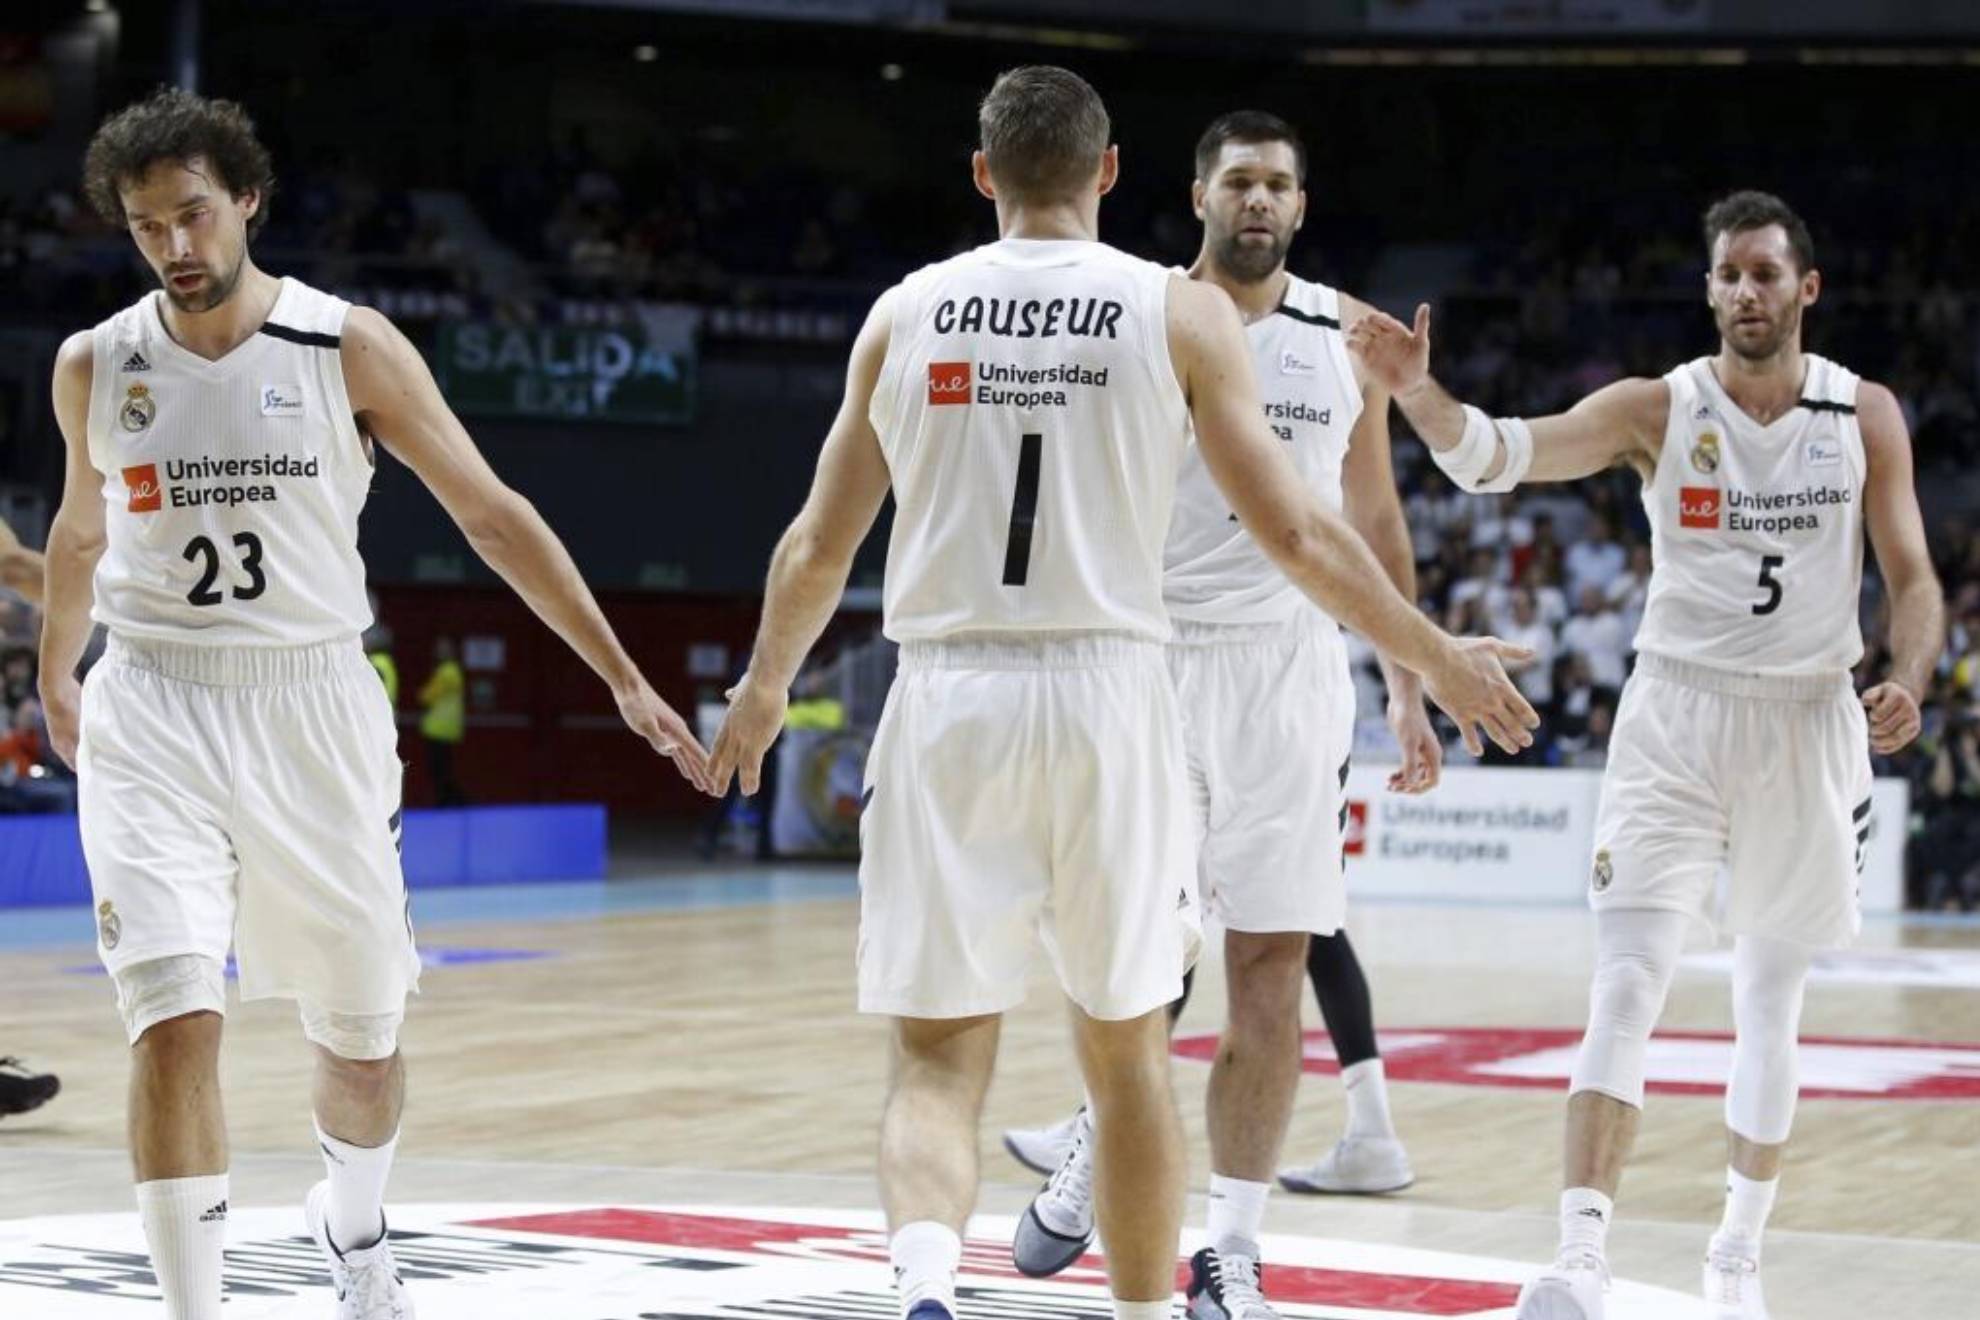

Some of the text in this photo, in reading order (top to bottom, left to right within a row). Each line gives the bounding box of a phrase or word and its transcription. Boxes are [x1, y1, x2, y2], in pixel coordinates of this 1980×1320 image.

[934, 296, 1122, 339] CAUSEUR
[453, 323, 680, 381] SALIDA
[978, 362, 1109, 387] Universidad
[976, 386, 1067, 410] Europea
[1264, 400, 1331, 425] rsidad
[166, 454, 319, 480] Universidad
[170, 485, 277, 507] Europea
[1002, 434, 1042, 586] 1
[1728, 513, 1819, 534] Europea
[182, 531, 266, 606] 23
[1751, 556, 1784, 615] 5
[1381, 804, 1569, 831] Universidad
[1381, 835, 1510, 862] Europea
